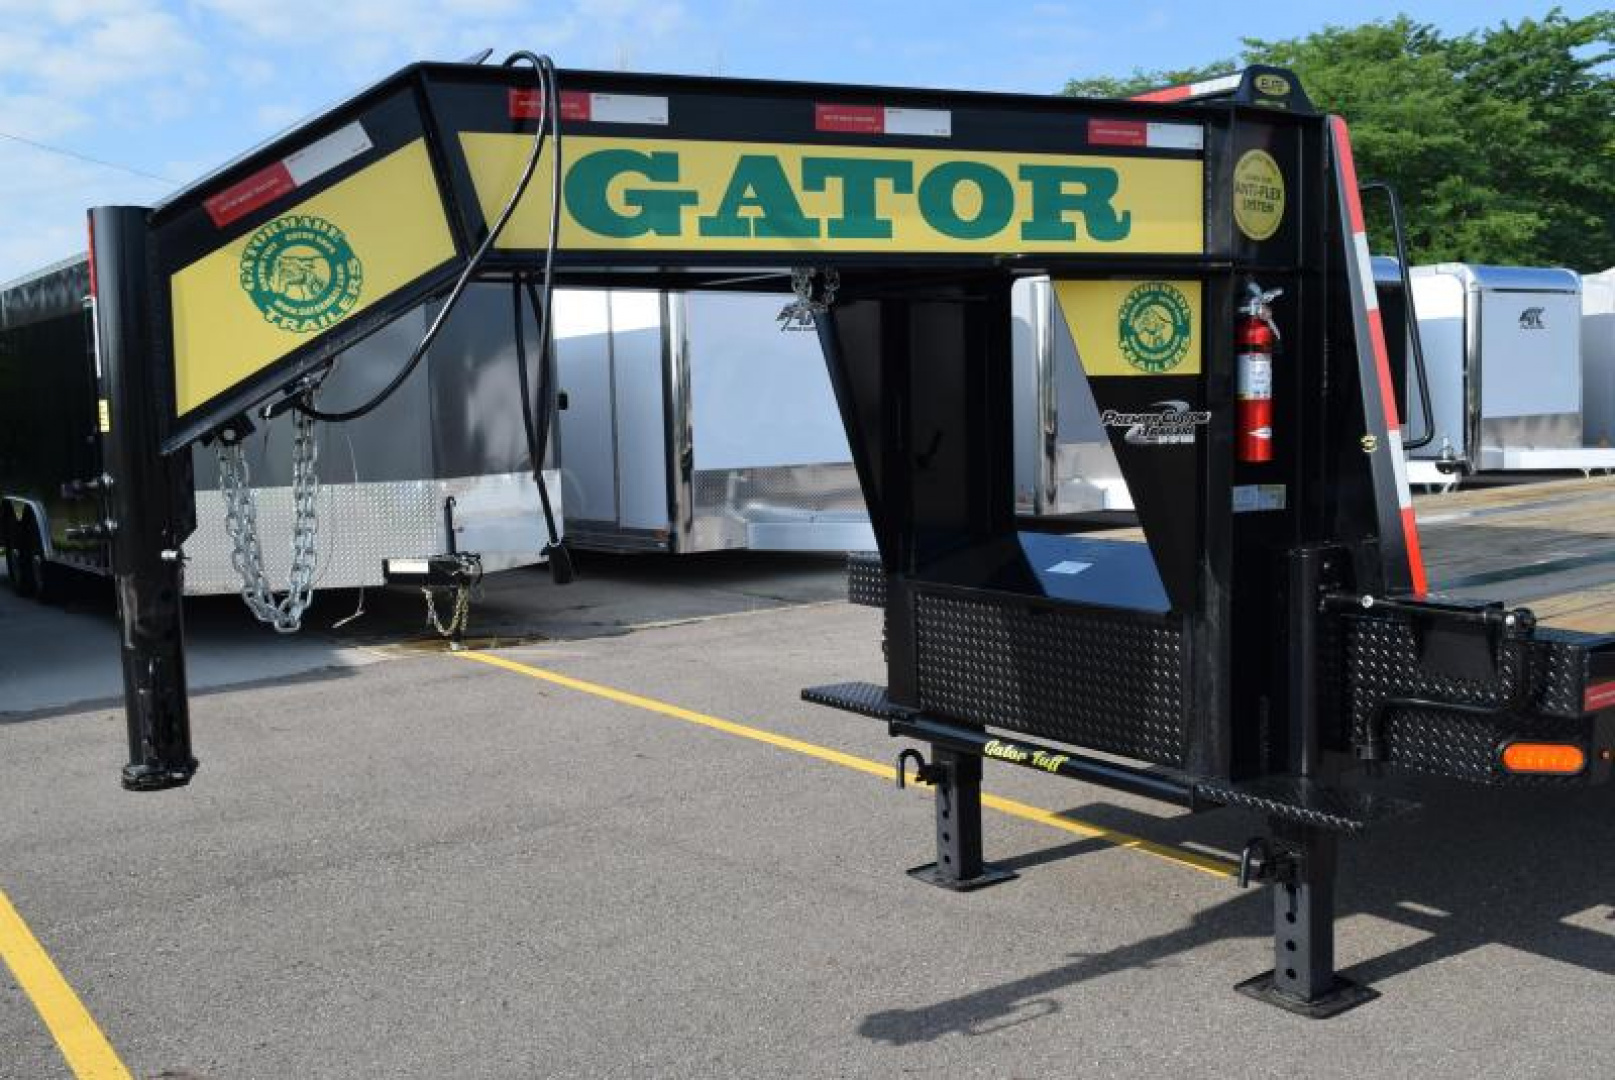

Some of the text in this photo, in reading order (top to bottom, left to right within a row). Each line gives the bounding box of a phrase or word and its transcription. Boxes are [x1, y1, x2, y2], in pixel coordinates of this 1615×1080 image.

[563, 148, 1132, 243] GATOR
[264, 257, 362, 333] TRAILERS
[984, 740, 1070, 772] Gator Tuff
